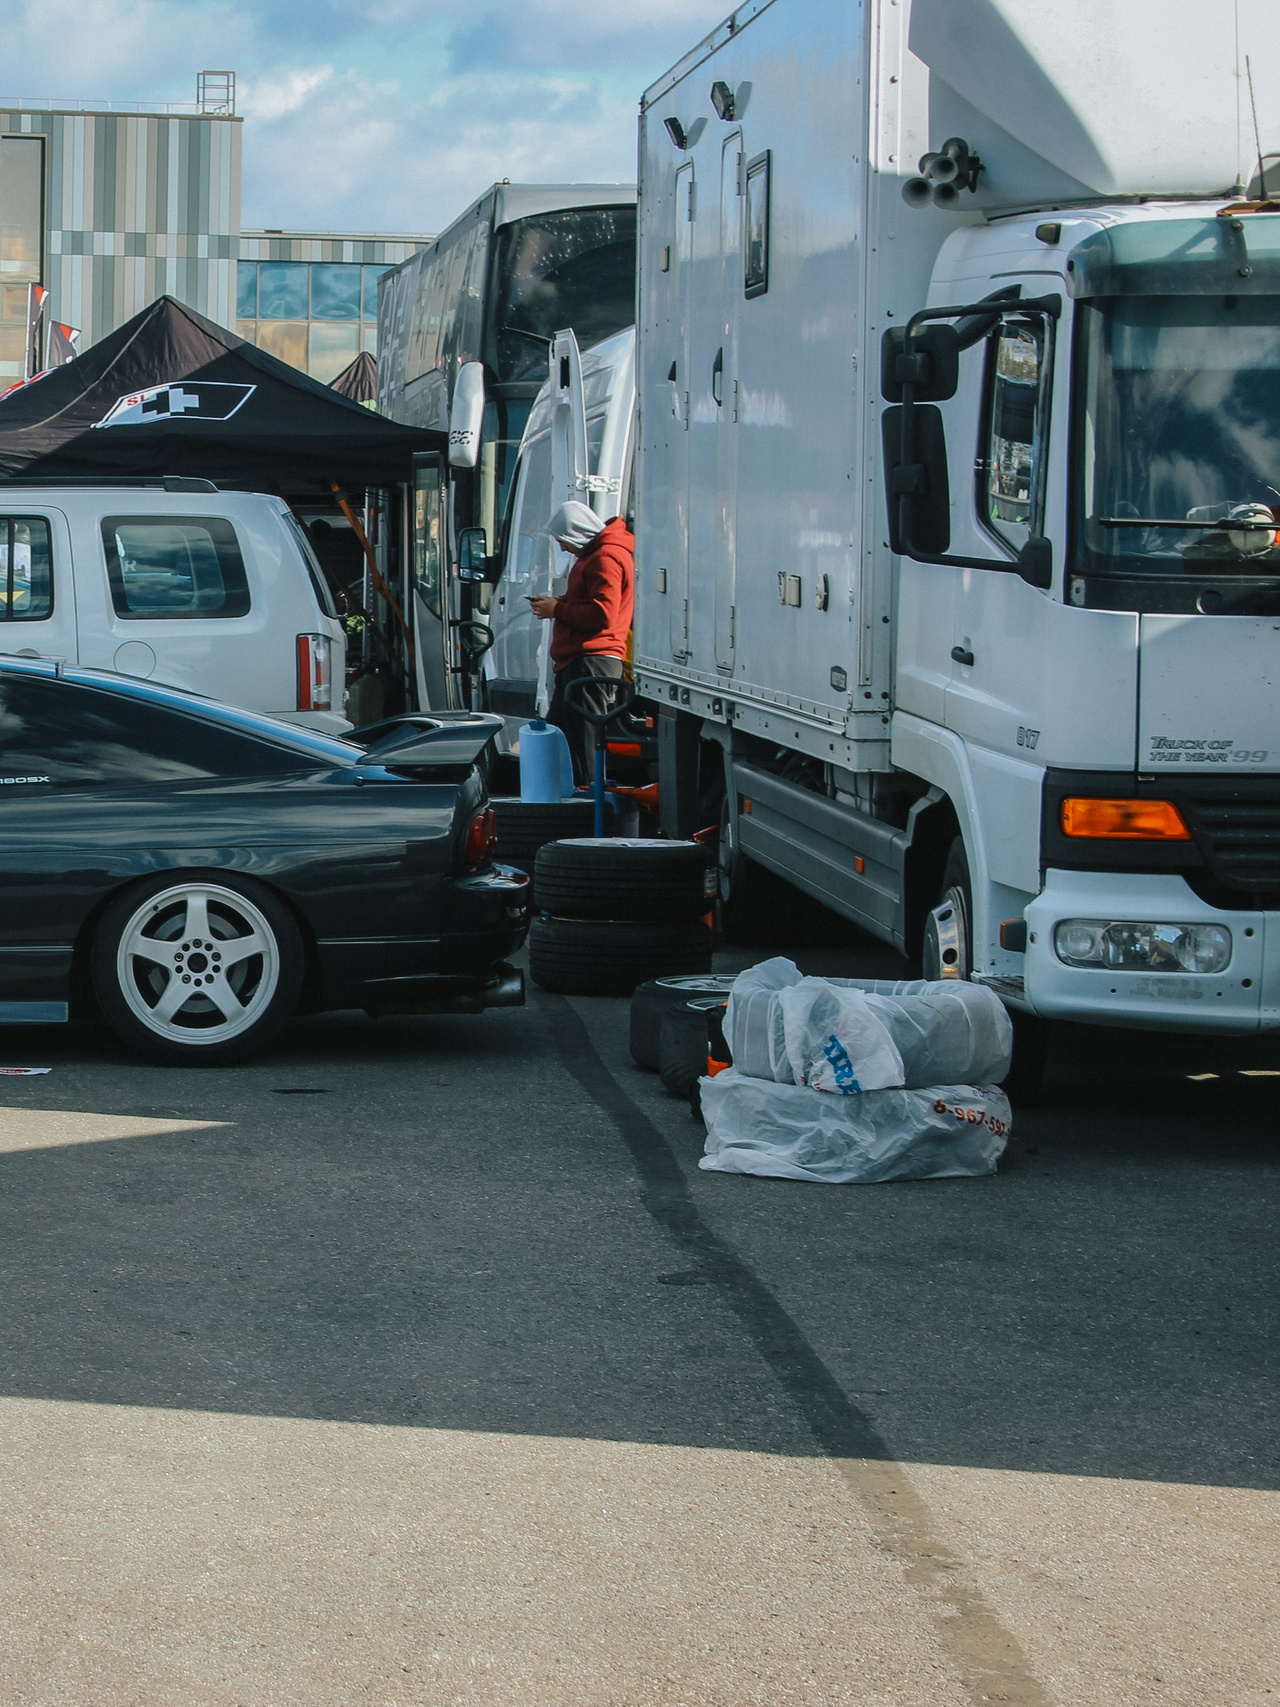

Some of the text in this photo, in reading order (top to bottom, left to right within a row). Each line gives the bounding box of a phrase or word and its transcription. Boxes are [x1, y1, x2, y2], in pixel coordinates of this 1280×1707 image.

[1206, 739, 1234, 750] OF
[1149, 751, 1182, 762] THE
[1184, 751, 1229, 762] YEAR
